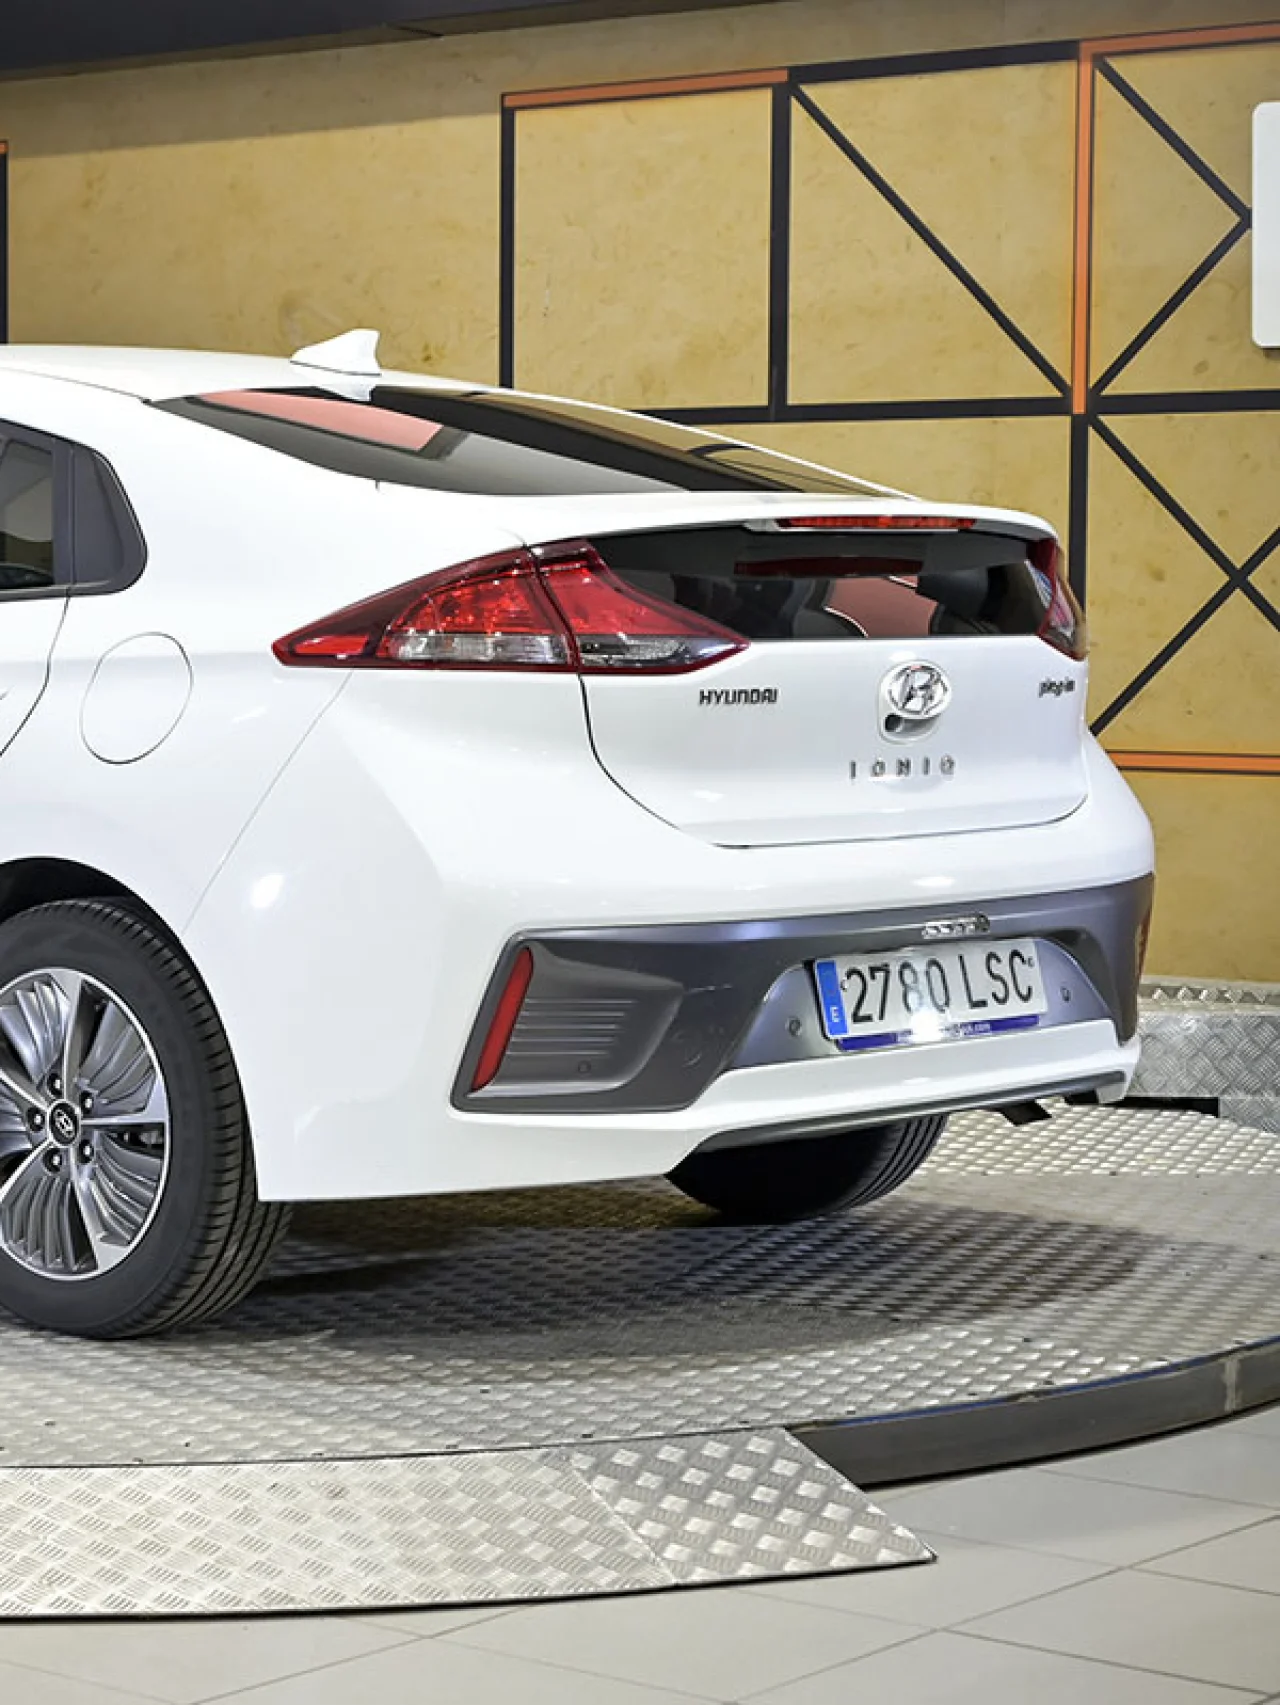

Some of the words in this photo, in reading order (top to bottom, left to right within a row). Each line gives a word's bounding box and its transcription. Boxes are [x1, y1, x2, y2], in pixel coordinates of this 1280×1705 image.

[699, 688, 778, 705] HYUNDAI
[843, 957, 951, 1023] 2780
[957, 949, 1033, 1009] LSC
